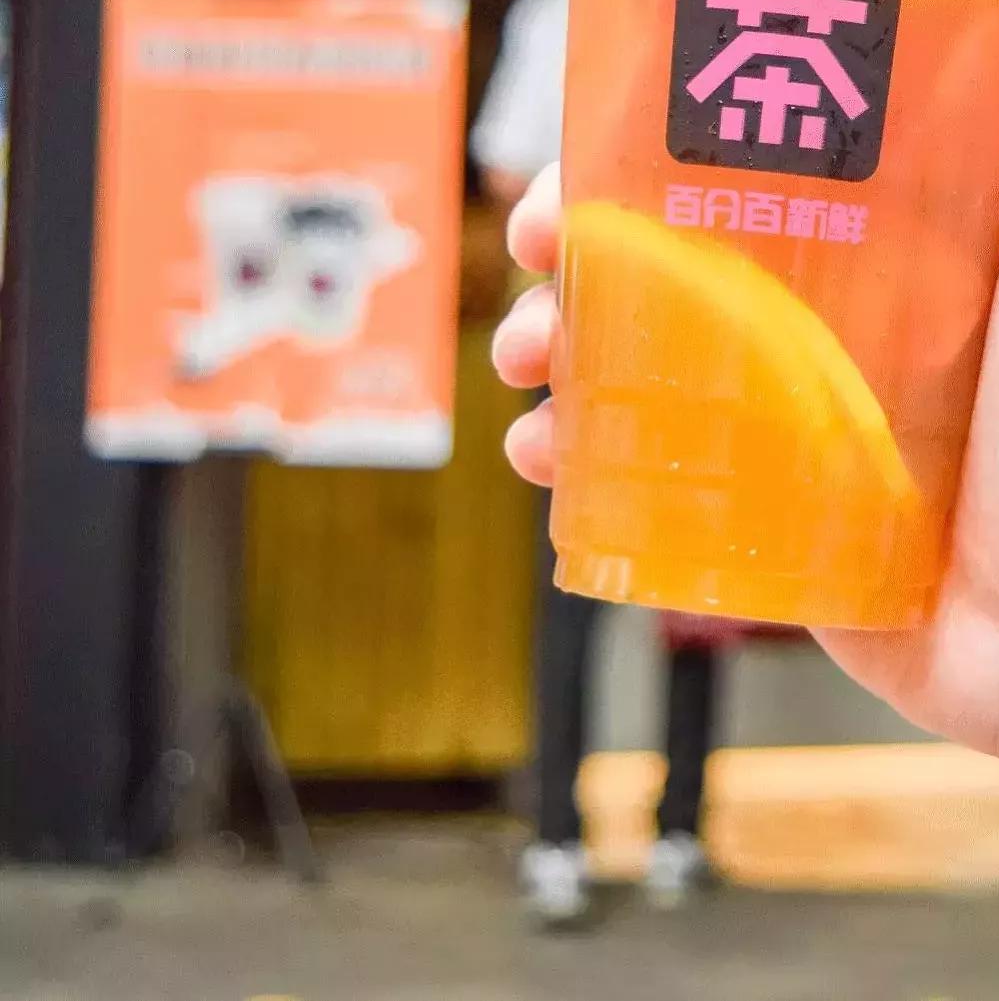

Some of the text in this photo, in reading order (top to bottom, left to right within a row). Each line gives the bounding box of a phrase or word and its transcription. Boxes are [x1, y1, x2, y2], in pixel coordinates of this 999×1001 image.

[665, 184, 869, 244] 百分百新鲜
